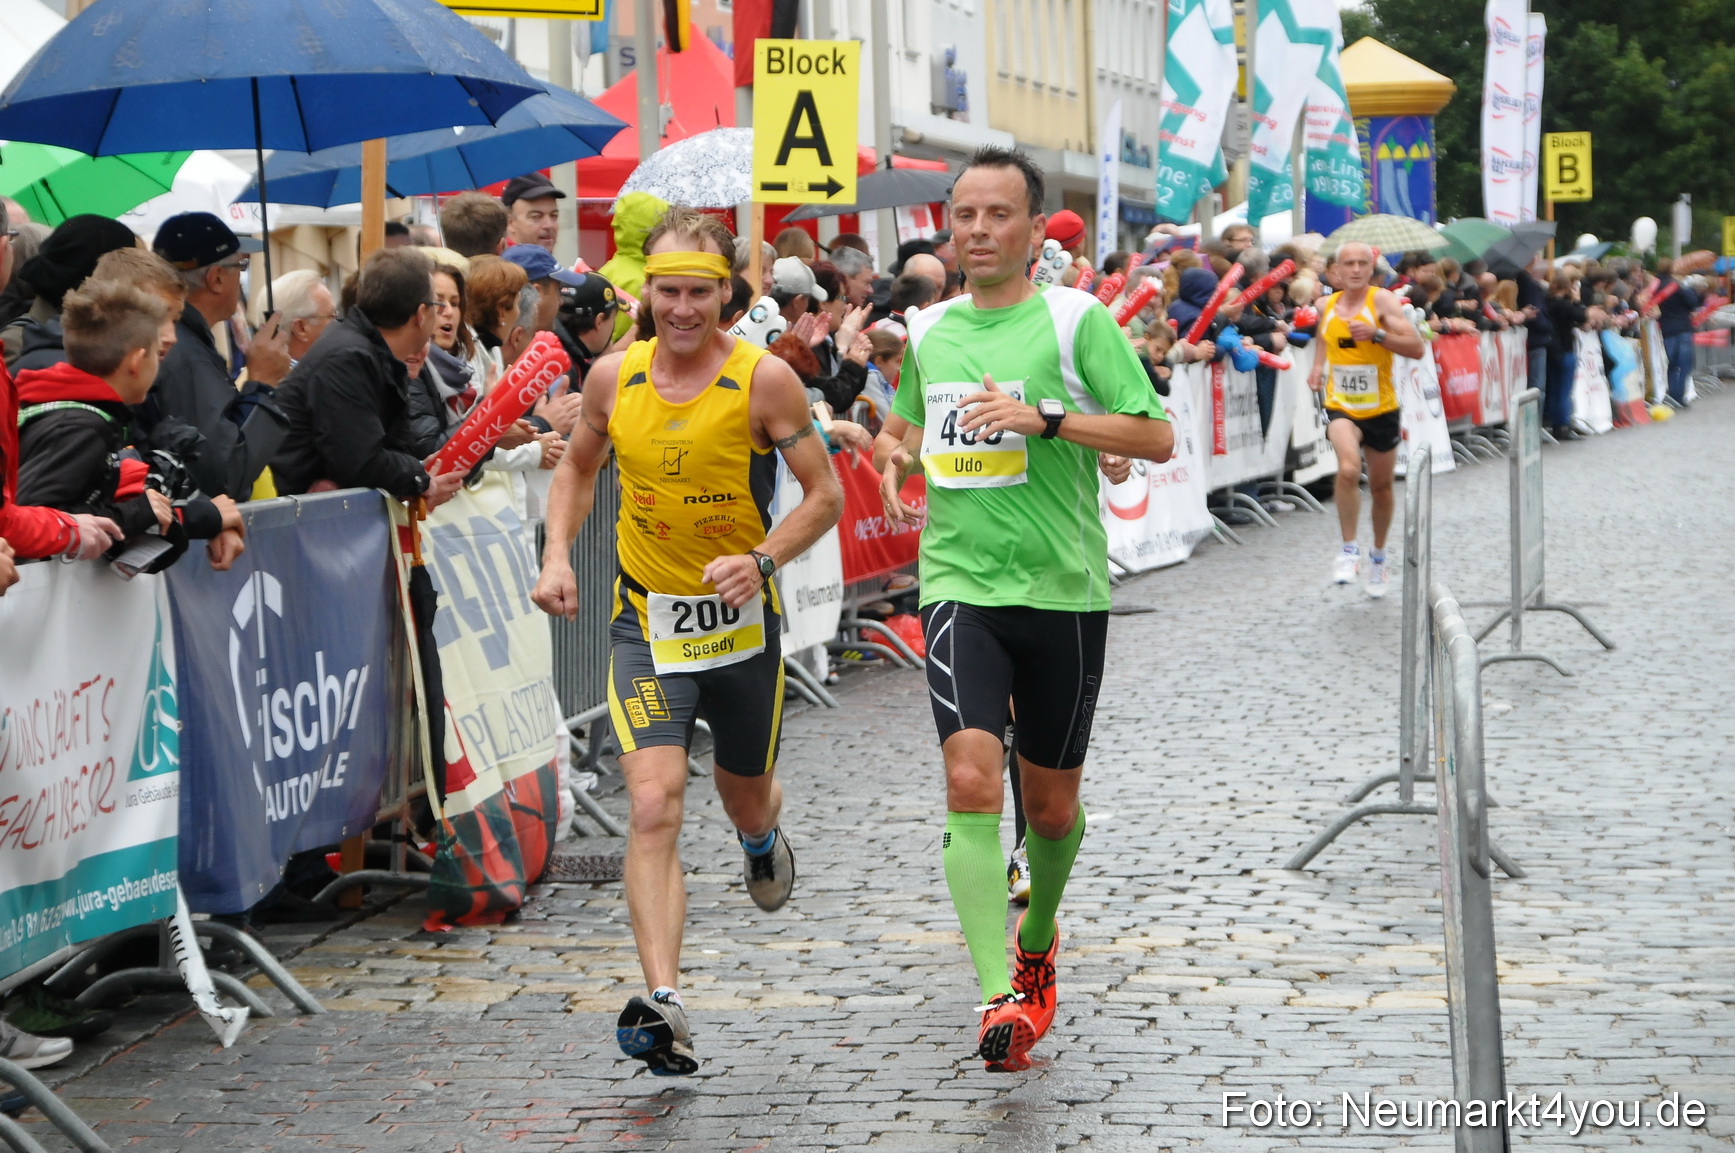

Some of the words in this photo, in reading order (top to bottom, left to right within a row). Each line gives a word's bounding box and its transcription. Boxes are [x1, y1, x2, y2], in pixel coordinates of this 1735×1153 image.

[766, 46, 847, 75] Block
[773, 89, 834, 167] A
[1551, 136, 1586, 149] Block
[1558, 153, 1580, 185] B
[1341, 375, 1369, 391] 445
[927, 393, 956, 405] PARTL
[467, 415, 510, 457] BKK
[954, 457, 982, 472] Udo
[693, 514, 736, 528] PIZZERIA
[703, 523, 733, 535] ELIO
[671, 600, 740, 633] 200
[682, 637, 735, 659] Speedy
[639, 681, 666, 716] Run!
